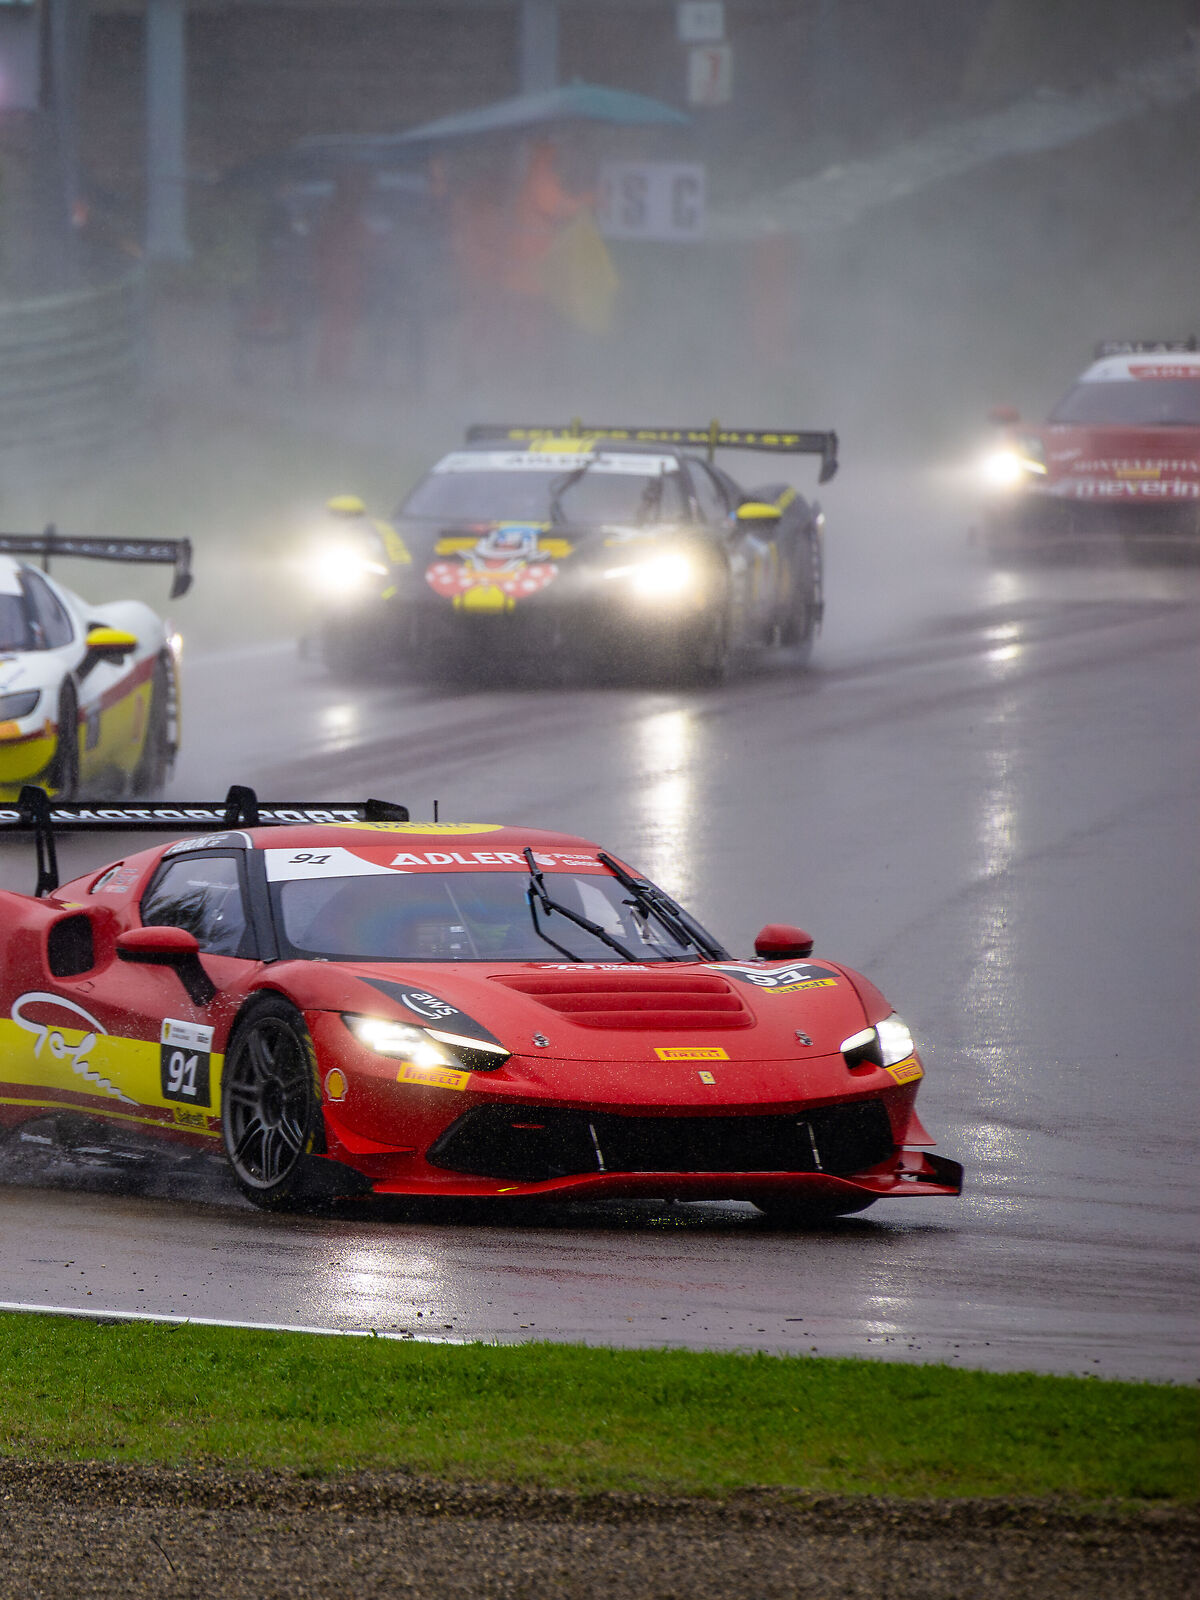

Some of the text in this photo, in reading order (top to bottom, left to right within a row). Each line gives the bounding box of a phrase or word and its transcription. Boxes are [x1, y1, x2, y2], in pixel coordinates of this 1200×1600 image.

[288, 852, 525, 866] 91 ADLER
[746, 970, 812, 987] 91
[410, 992, 460, 1016] aws
[661, 1049, 721, 1058] PIRELLI
[167, 1051, 199, 1096] 91
[402, 1066, 463, 1086] PIRELLI
